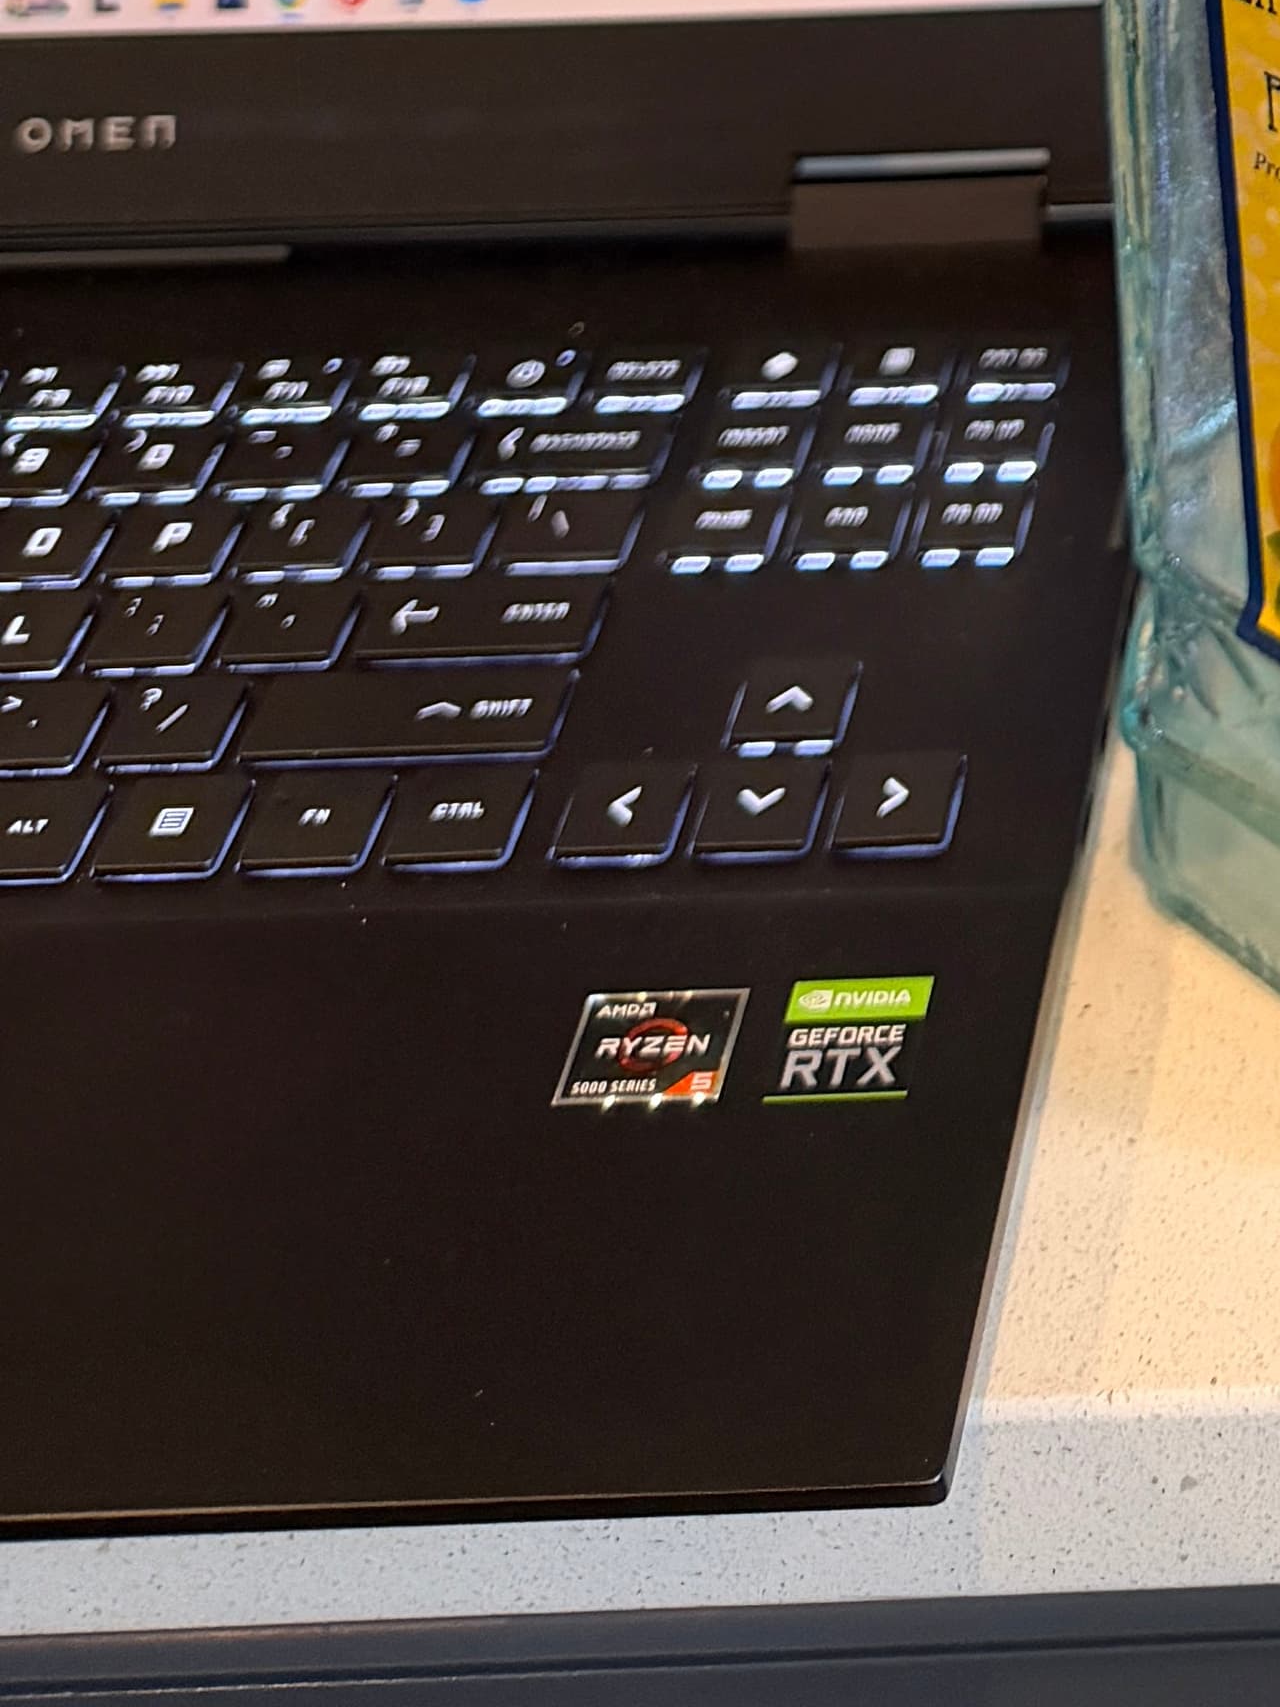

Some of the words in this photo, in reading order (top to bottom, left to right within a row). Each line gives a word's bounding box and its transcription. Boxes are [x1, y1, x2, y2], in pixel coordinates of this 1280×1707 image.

[1, 615, 30, 646] L
[6, 818, 49, 834] ALT
[298, 808, 331, 827] FN
[594, 1034, 710, 1058] RYZEN
[787, 1024, 906, 1046] GEFORCE
[780, 1046, 900, 1088] RTX
[571, 1081, 607, 1095] 5000
[608, 1078, 657, 1094] SERIES
